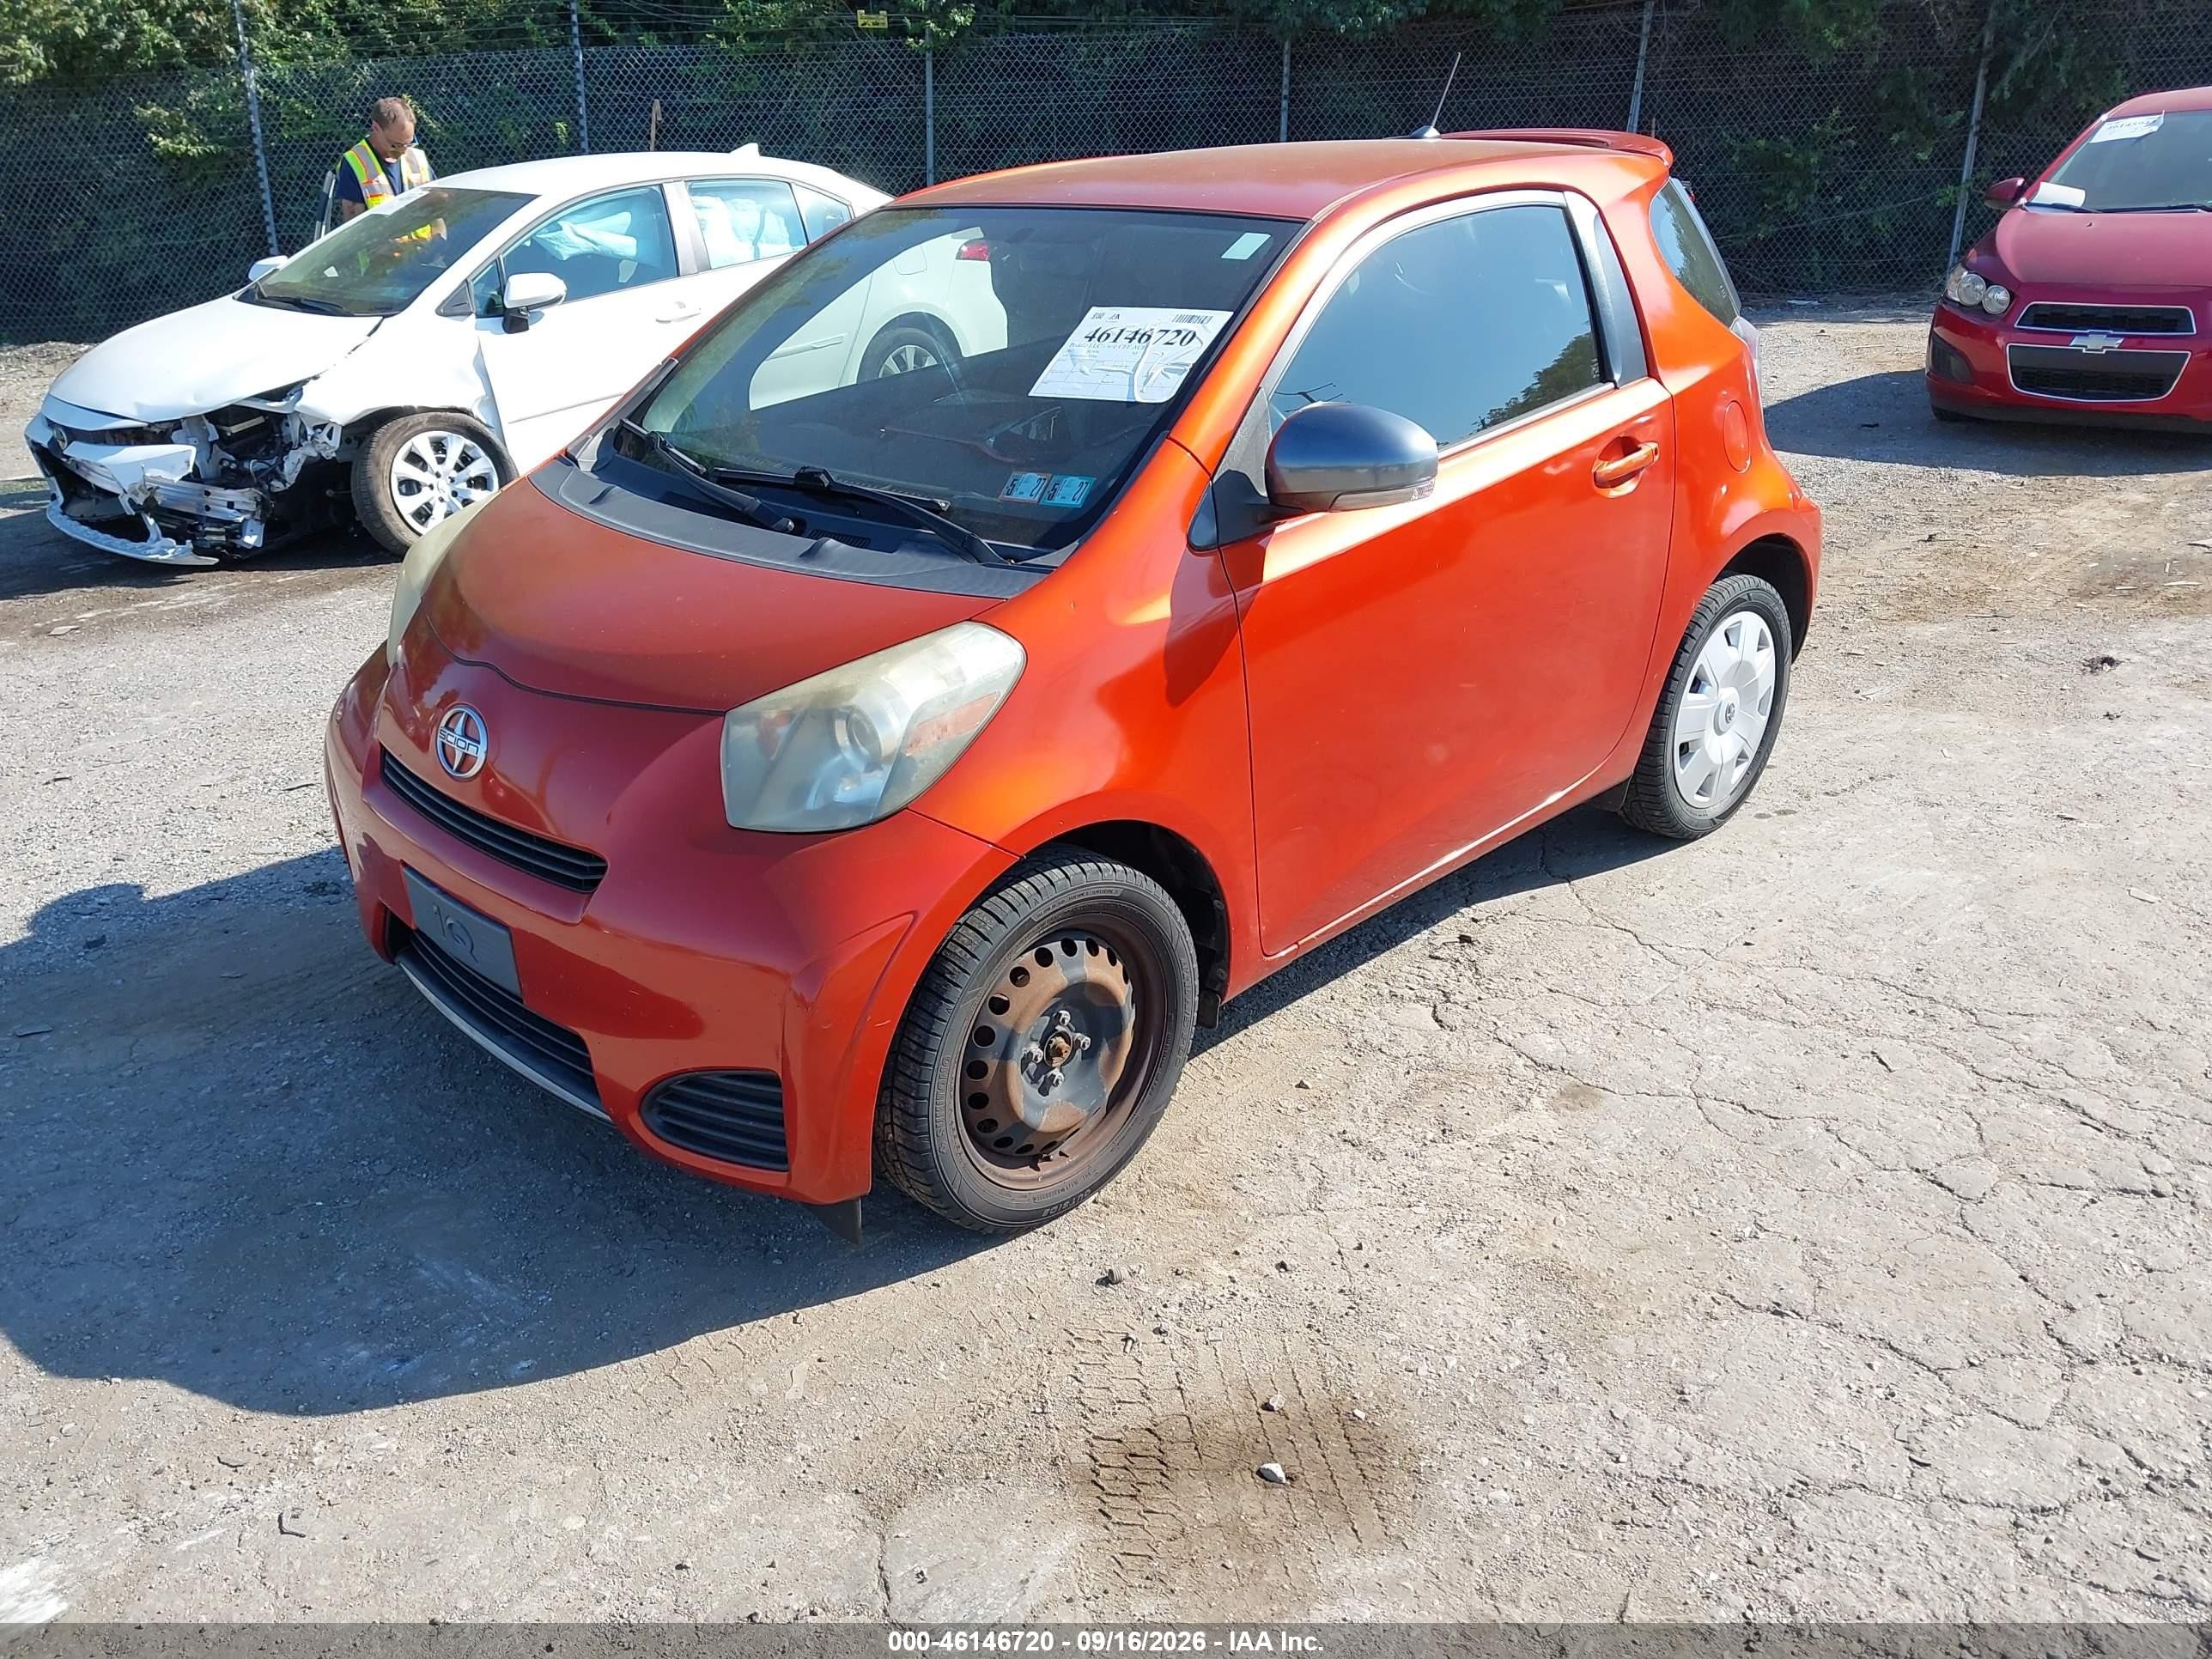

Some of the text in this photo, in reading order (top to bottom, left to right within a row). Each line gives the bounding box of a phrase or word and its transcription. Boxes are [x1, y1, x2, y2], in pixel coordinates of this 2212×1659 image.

[1084, 326, 1197, 347] 46146720
[1029, 477, 1047, 499] 27
[1071, 481, 1090, 503] 27
[439, 727, 479, 756] SCION
[935, 1056, 951, 1138] SUMITOMO
[1042, 1188, 1092, 1217] OUTSIDE
